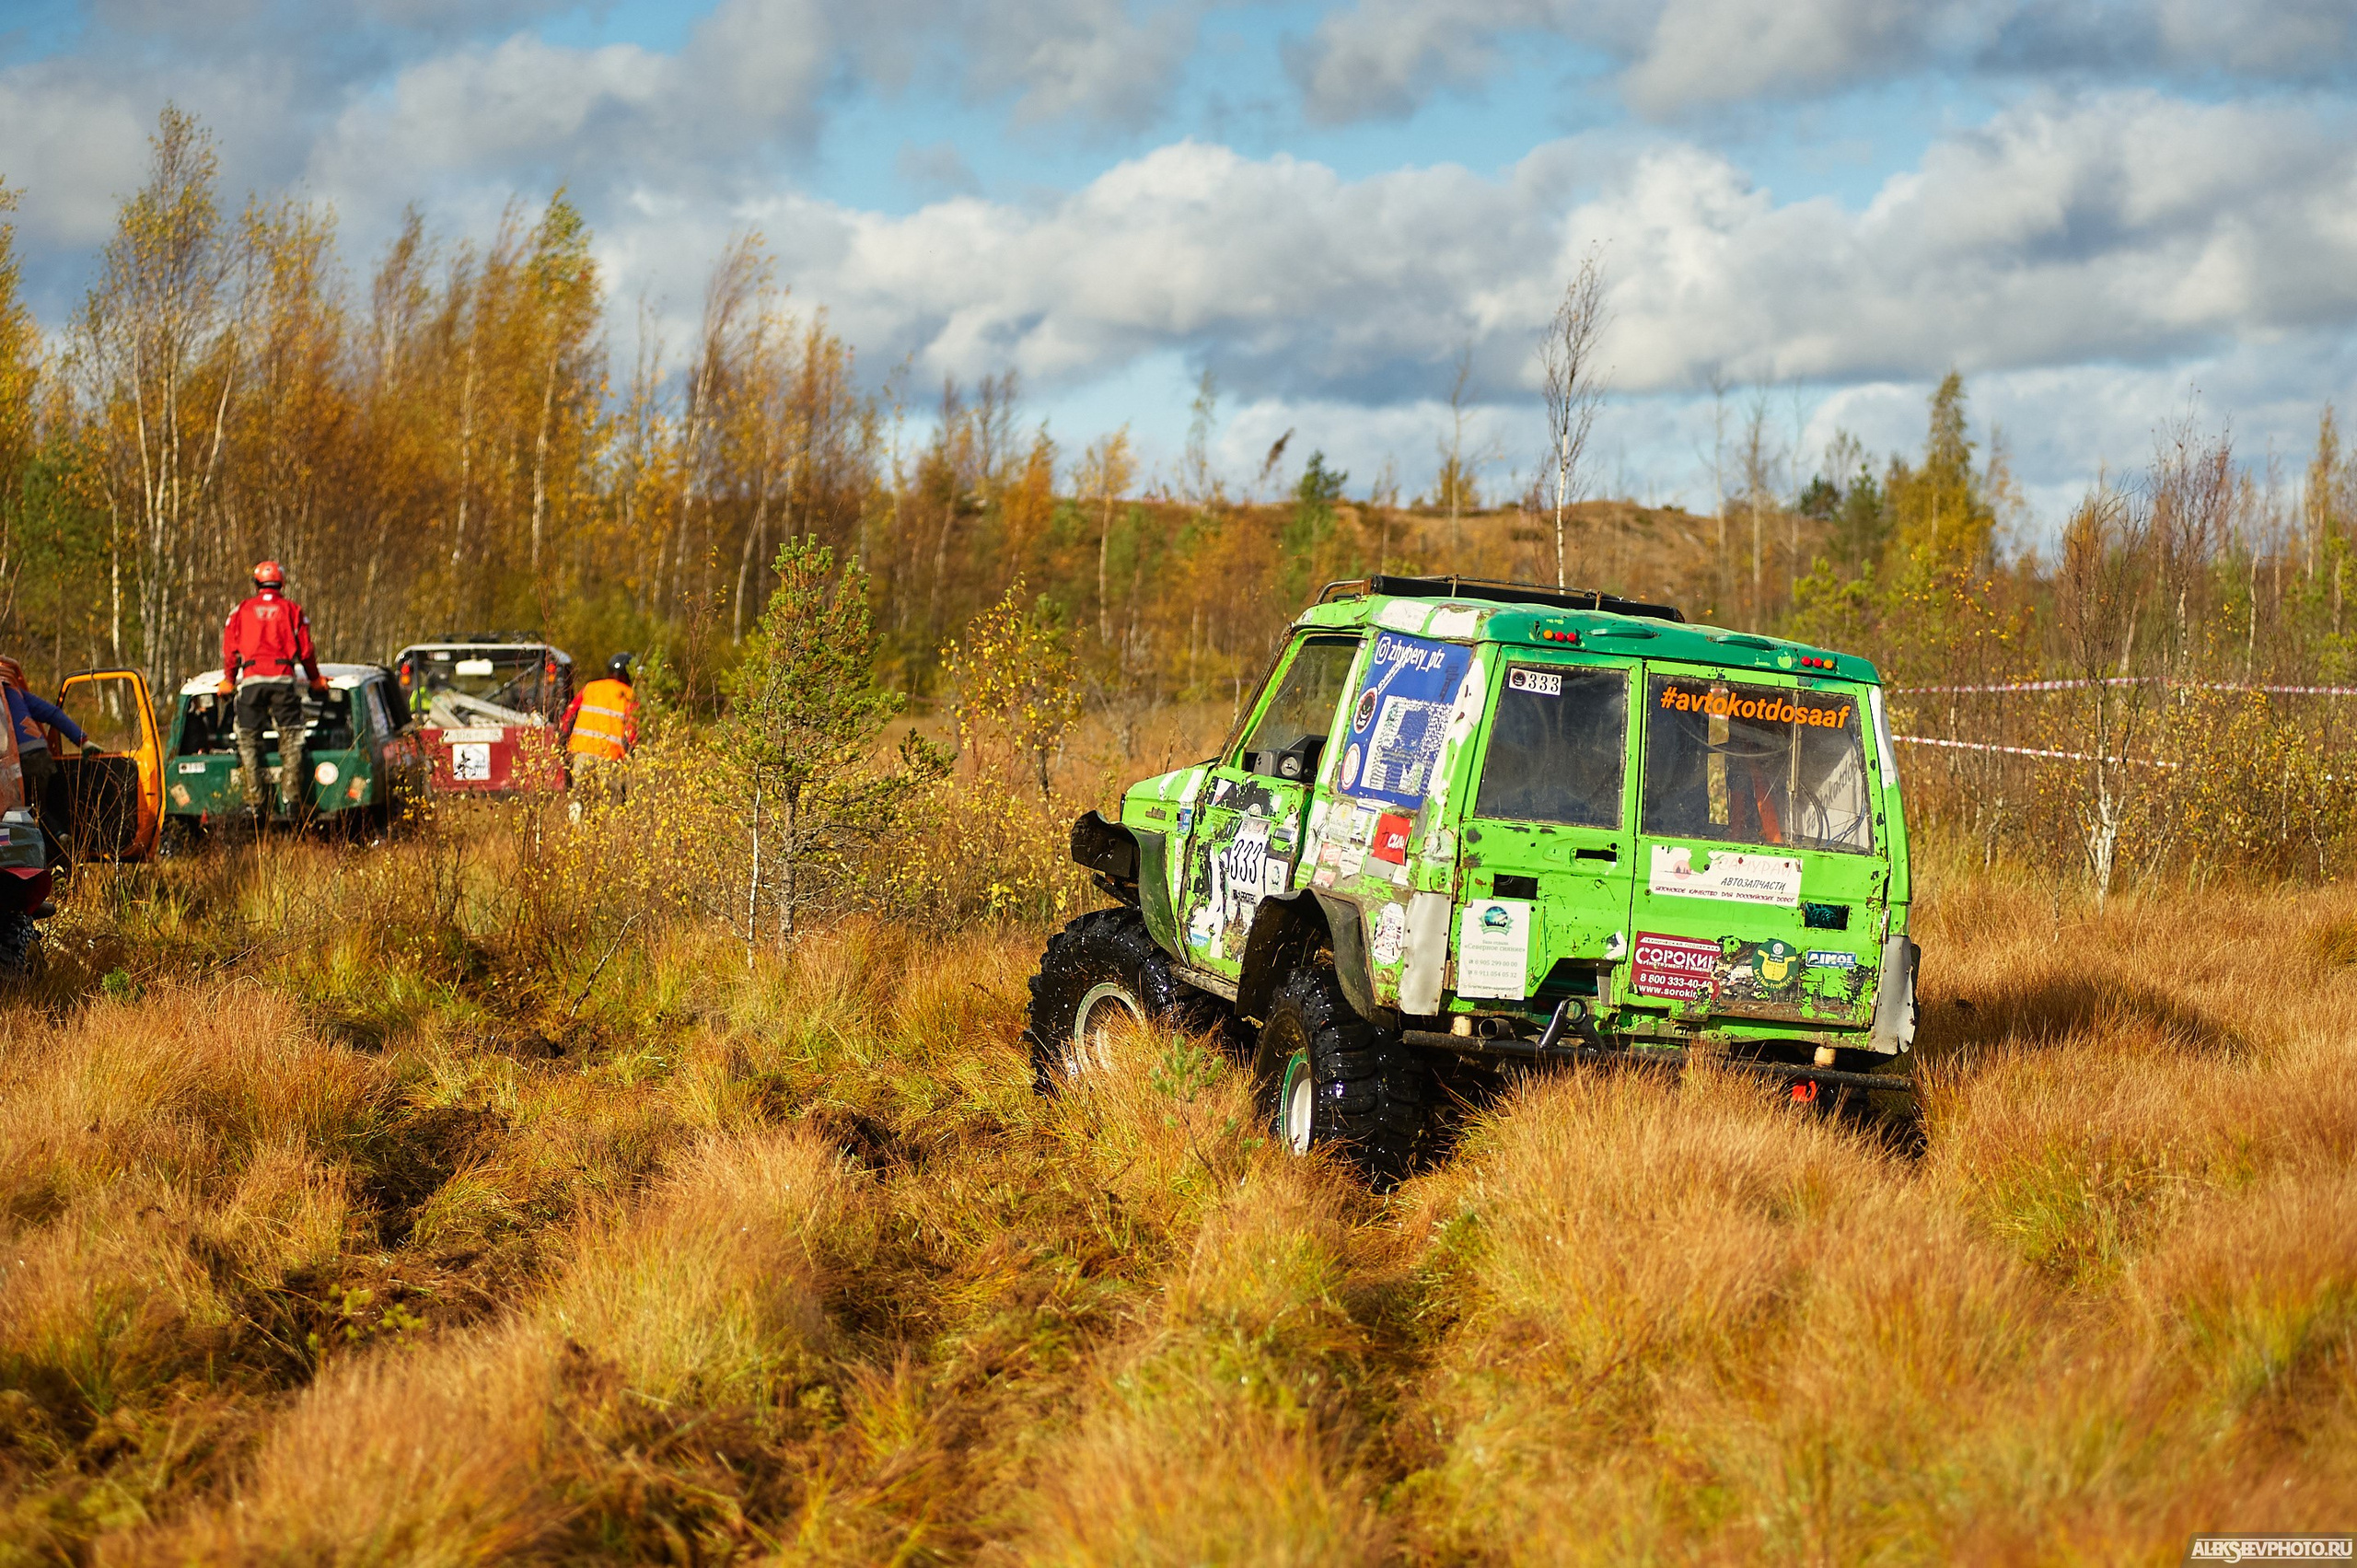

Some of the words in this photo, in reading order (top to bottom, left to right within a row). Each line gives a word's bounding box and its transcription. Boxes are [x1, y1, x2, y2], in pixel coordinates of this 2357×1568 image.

[1528, 674, 1559, 691] 333
[1660, 686, 1851, 728] #avtokotdosaaf
[1230, 839, 1262, 884] 333
[1718, 857, 1792, 877] САМУРАЙ
[1721, 877, 1786, 891] АВТОЗАПЧАСТИ
[1655, 886, 1686, 894] ЯПОНСКОЕ
[1689, 889, 1718, 897] КАЧЕСТВО
[1736, 892, 1774, 901] РОССИЙСКИХ
[1644, 937, 1683, 947] ТЕХНИЧЕСКАЯ
[1684, 942, 1719, 951] ПОДДЕРЖКА
[1642, 959, 1683, 970] ИНСТРУМЕНТ
[1808, 953, 1854, 965] AIMOL
[1640, 973, 1646, 982] 8
[1648, 974, 1666, 984] 800
[1667, 976, 1713, 989] 333-40-40
